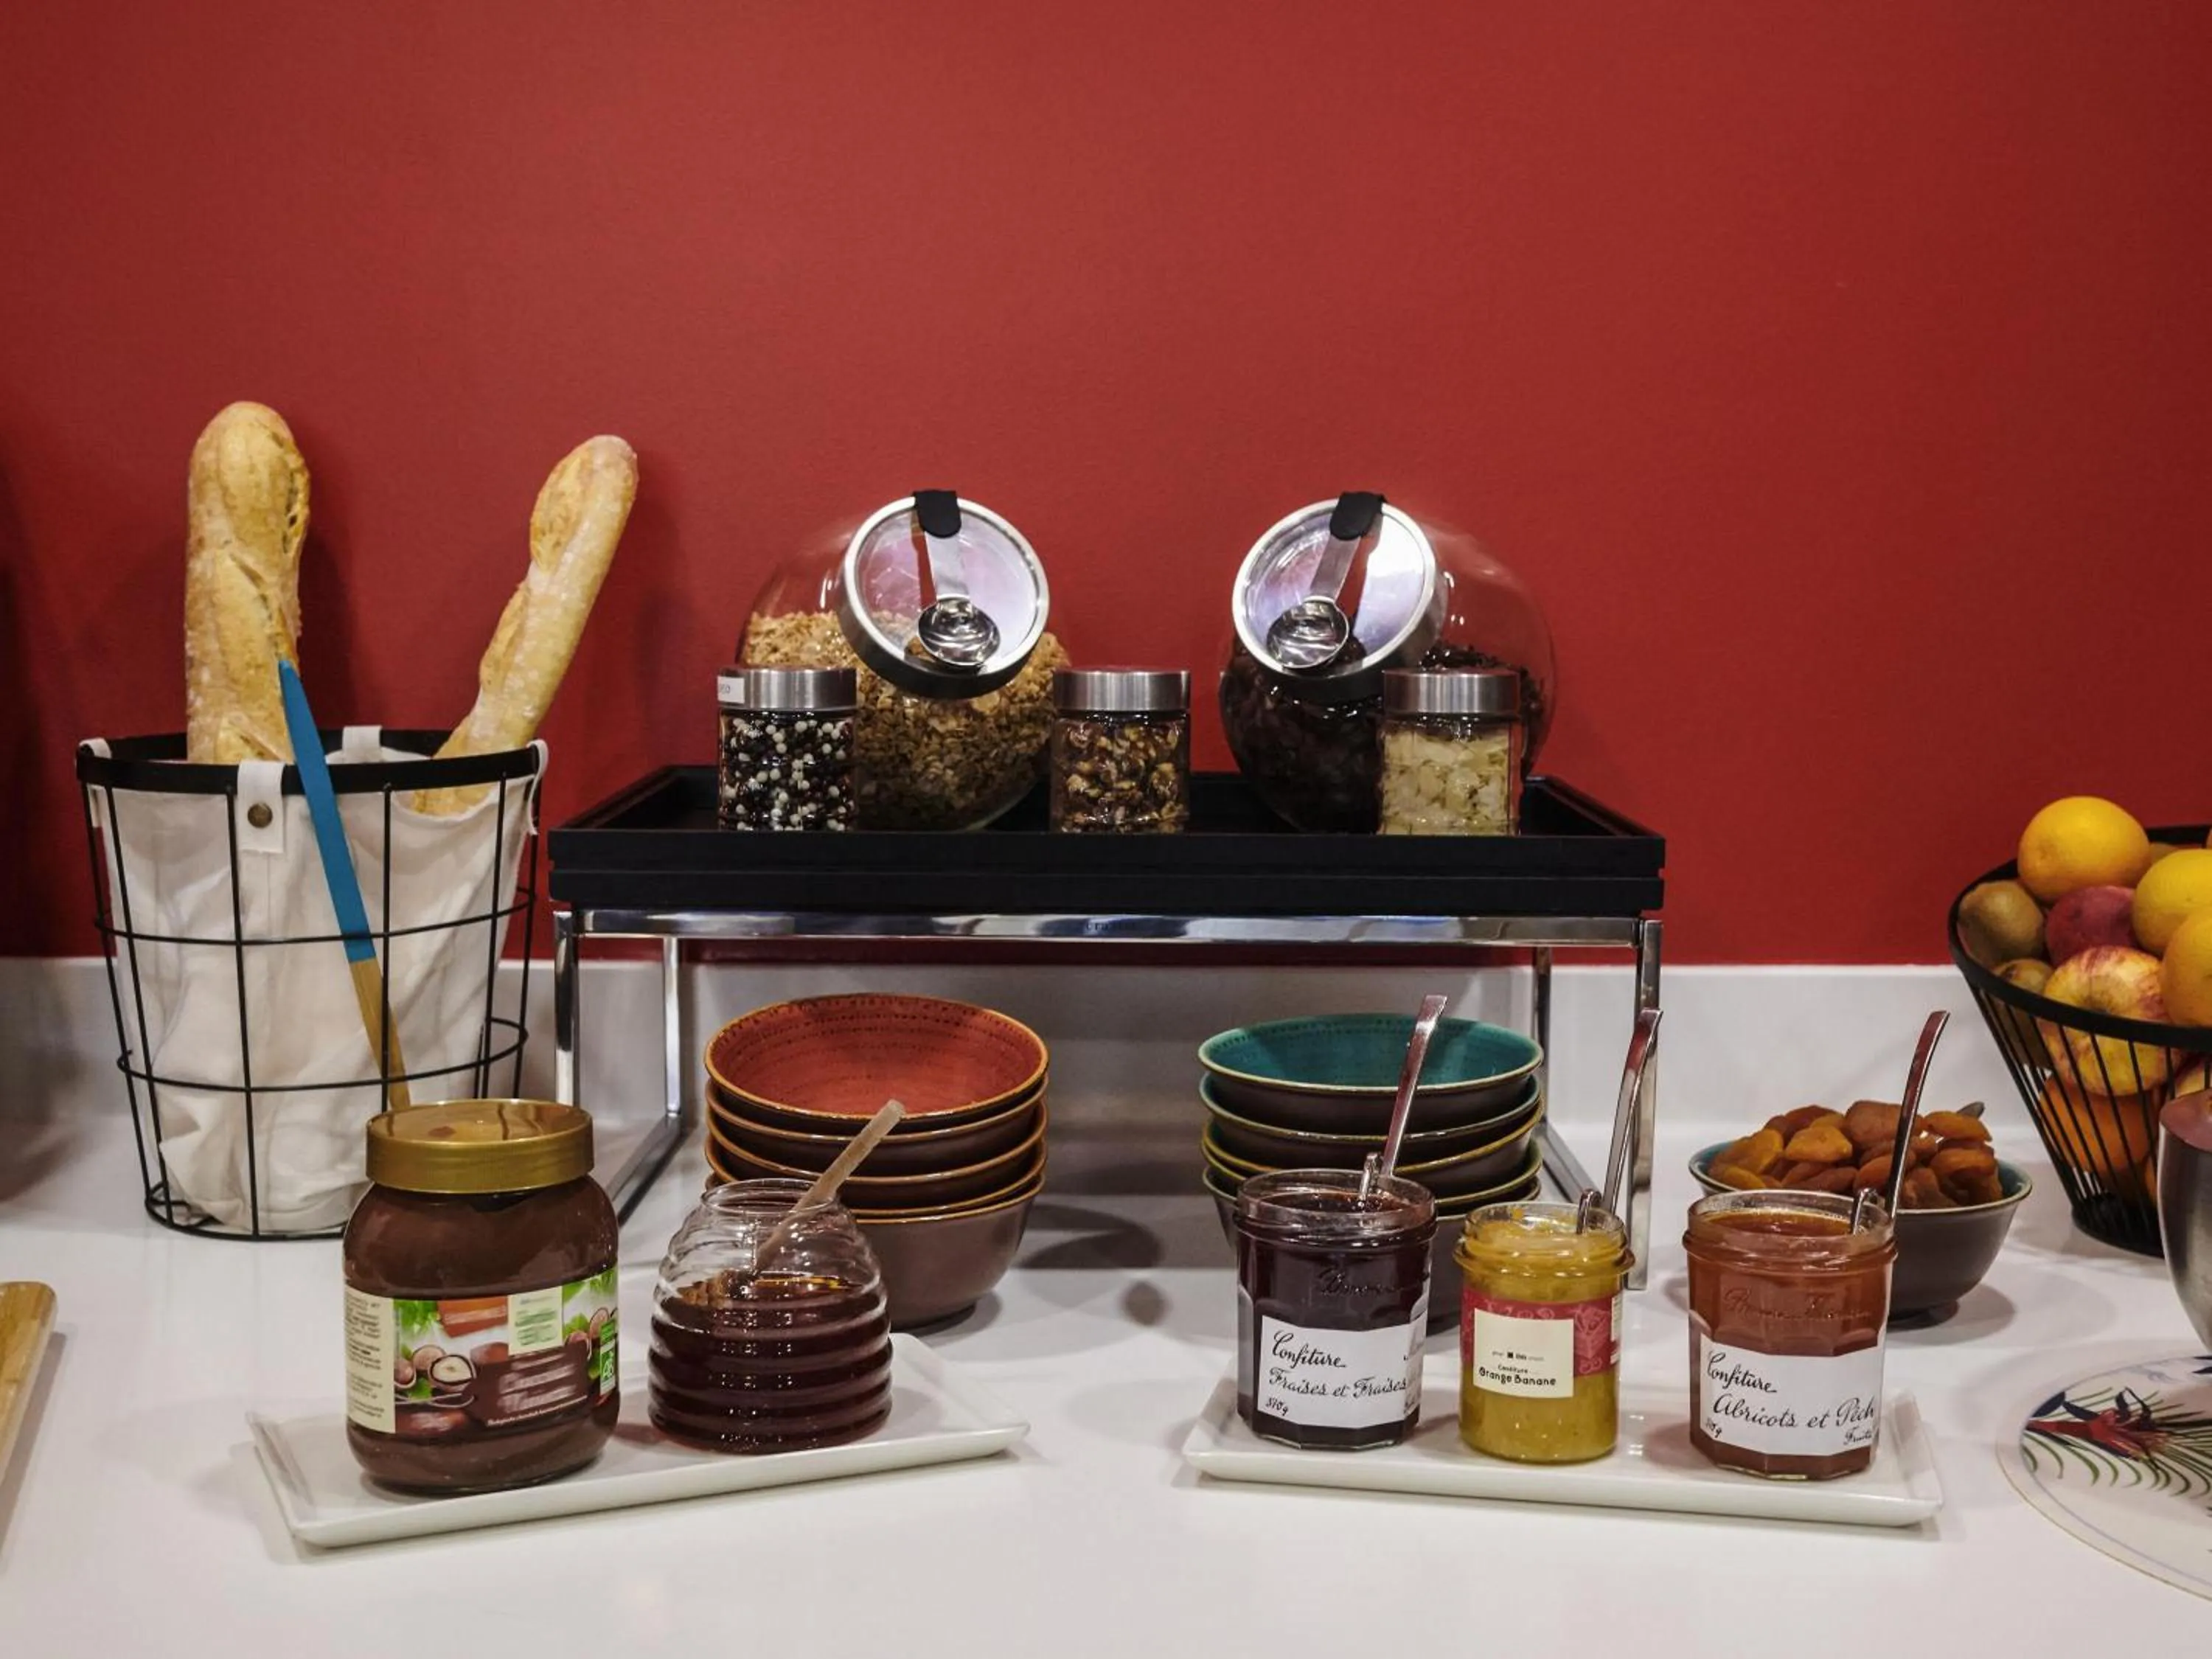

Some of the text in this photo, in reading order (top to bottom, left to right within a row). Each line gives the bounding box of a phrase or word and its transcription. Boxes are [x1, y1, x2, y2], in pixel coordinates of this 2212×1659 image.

[1272, 1330, 1346, 1369] Confiture
[1269, 1367, 1329, 1397] Fraises
[1332, 1385, 1351, 1398] et
[1478, 1366, 1557, 1386] Orange Banane
[1707, 1351, 1778, 1393] Confiture
[1713, 1393, 1798, 1427] Abricots
[1806, 1409, 1830, 1429] et
